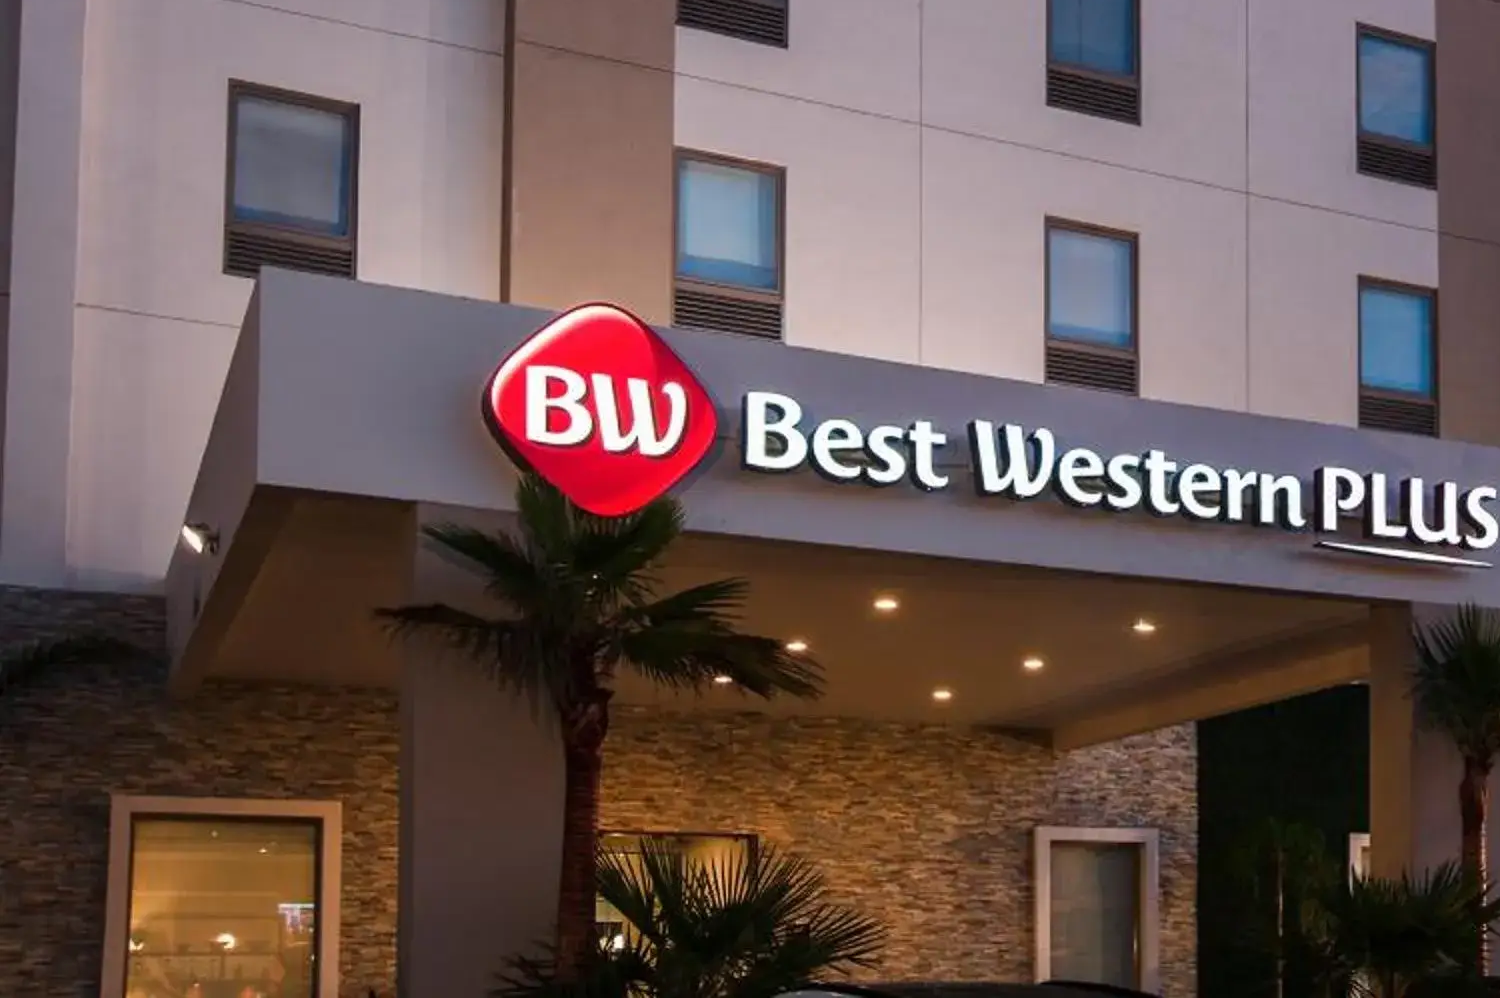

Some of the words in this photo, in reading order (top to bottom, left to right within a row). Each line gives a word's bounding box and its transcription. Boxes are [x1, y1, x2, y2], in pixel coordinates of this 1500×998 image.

[525, 365, 686, 456] BW
[745, 391, 949, 488] Best
[974, 418, 1306, 528] Western
[1322, 466, 1499, 549] PLUS
